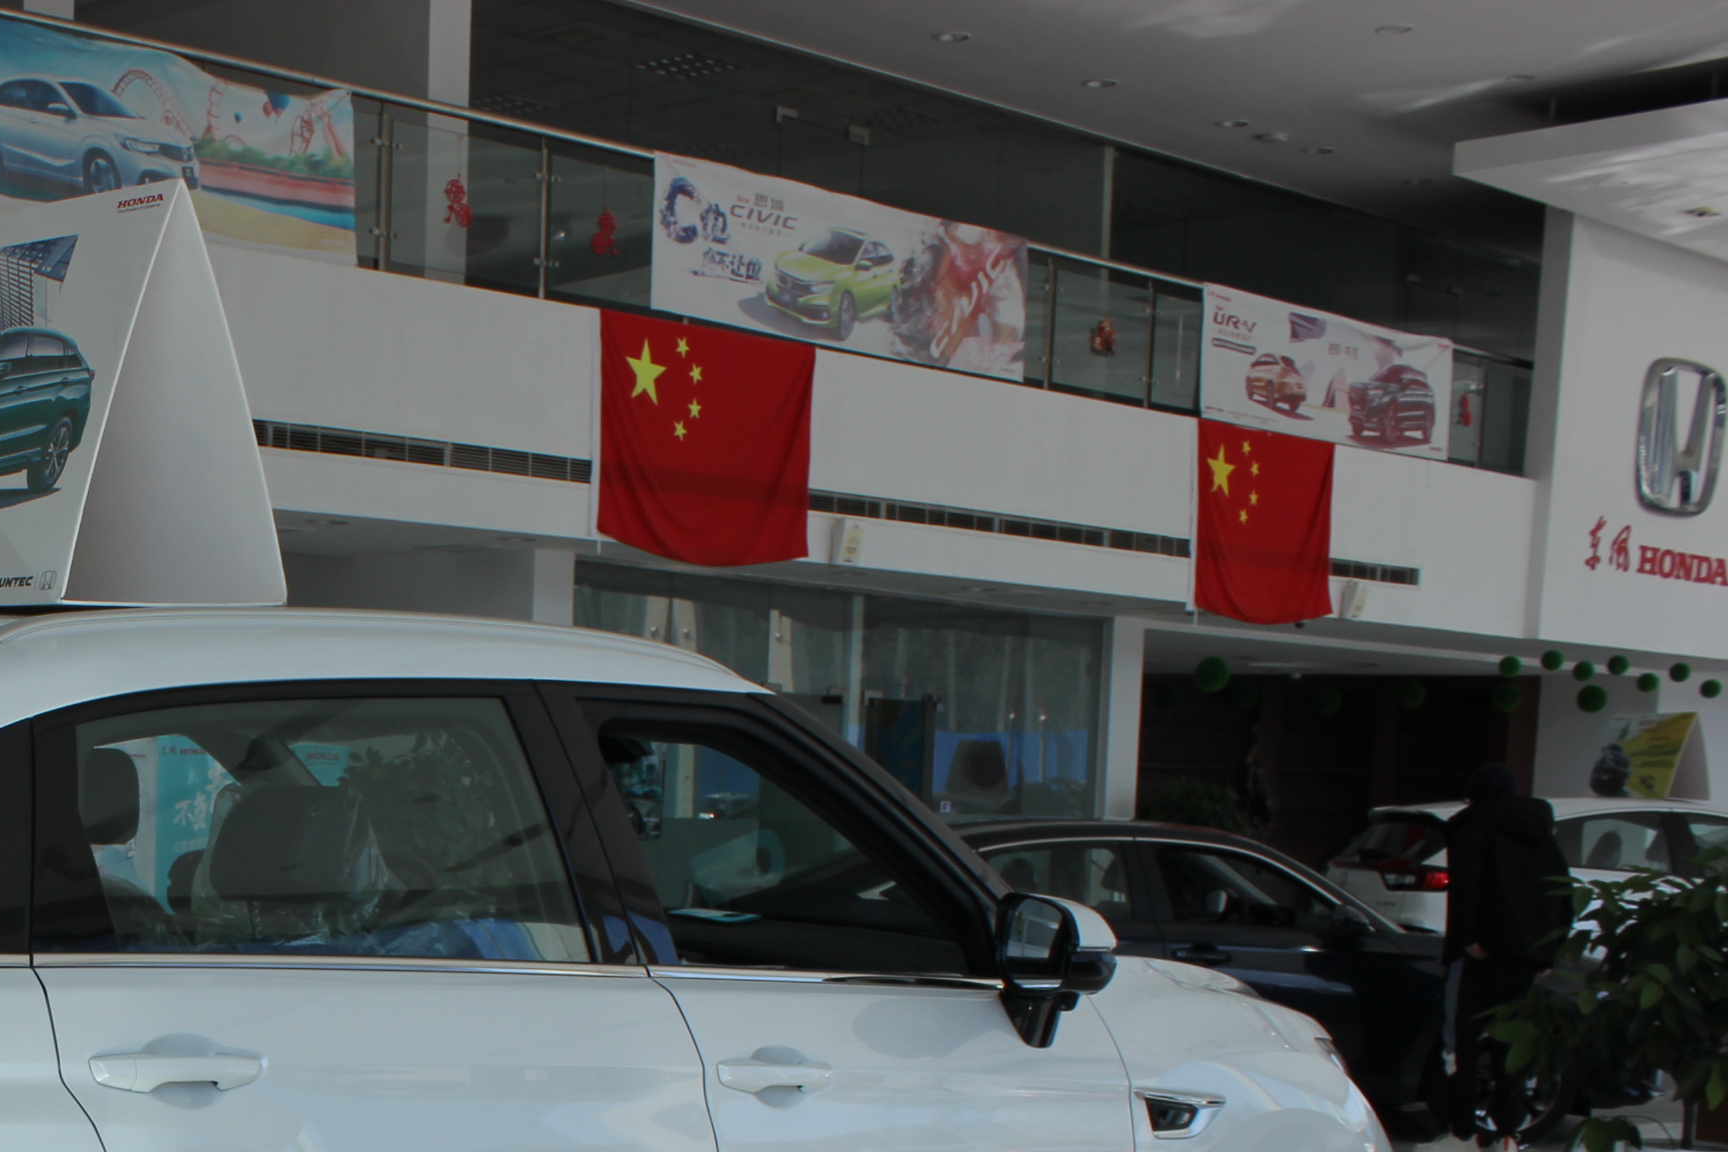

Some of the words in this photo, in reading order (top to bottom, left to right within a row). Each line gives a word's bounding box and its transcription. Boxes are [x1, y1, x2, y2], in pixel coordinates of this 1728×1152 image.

[117, 193, 164, 208] HONDA
[730, 204, 799, 230] CIVIC
[1212, 311, 1257, 334] UR-V
[1636, 544, 1728, 587] HONDA
